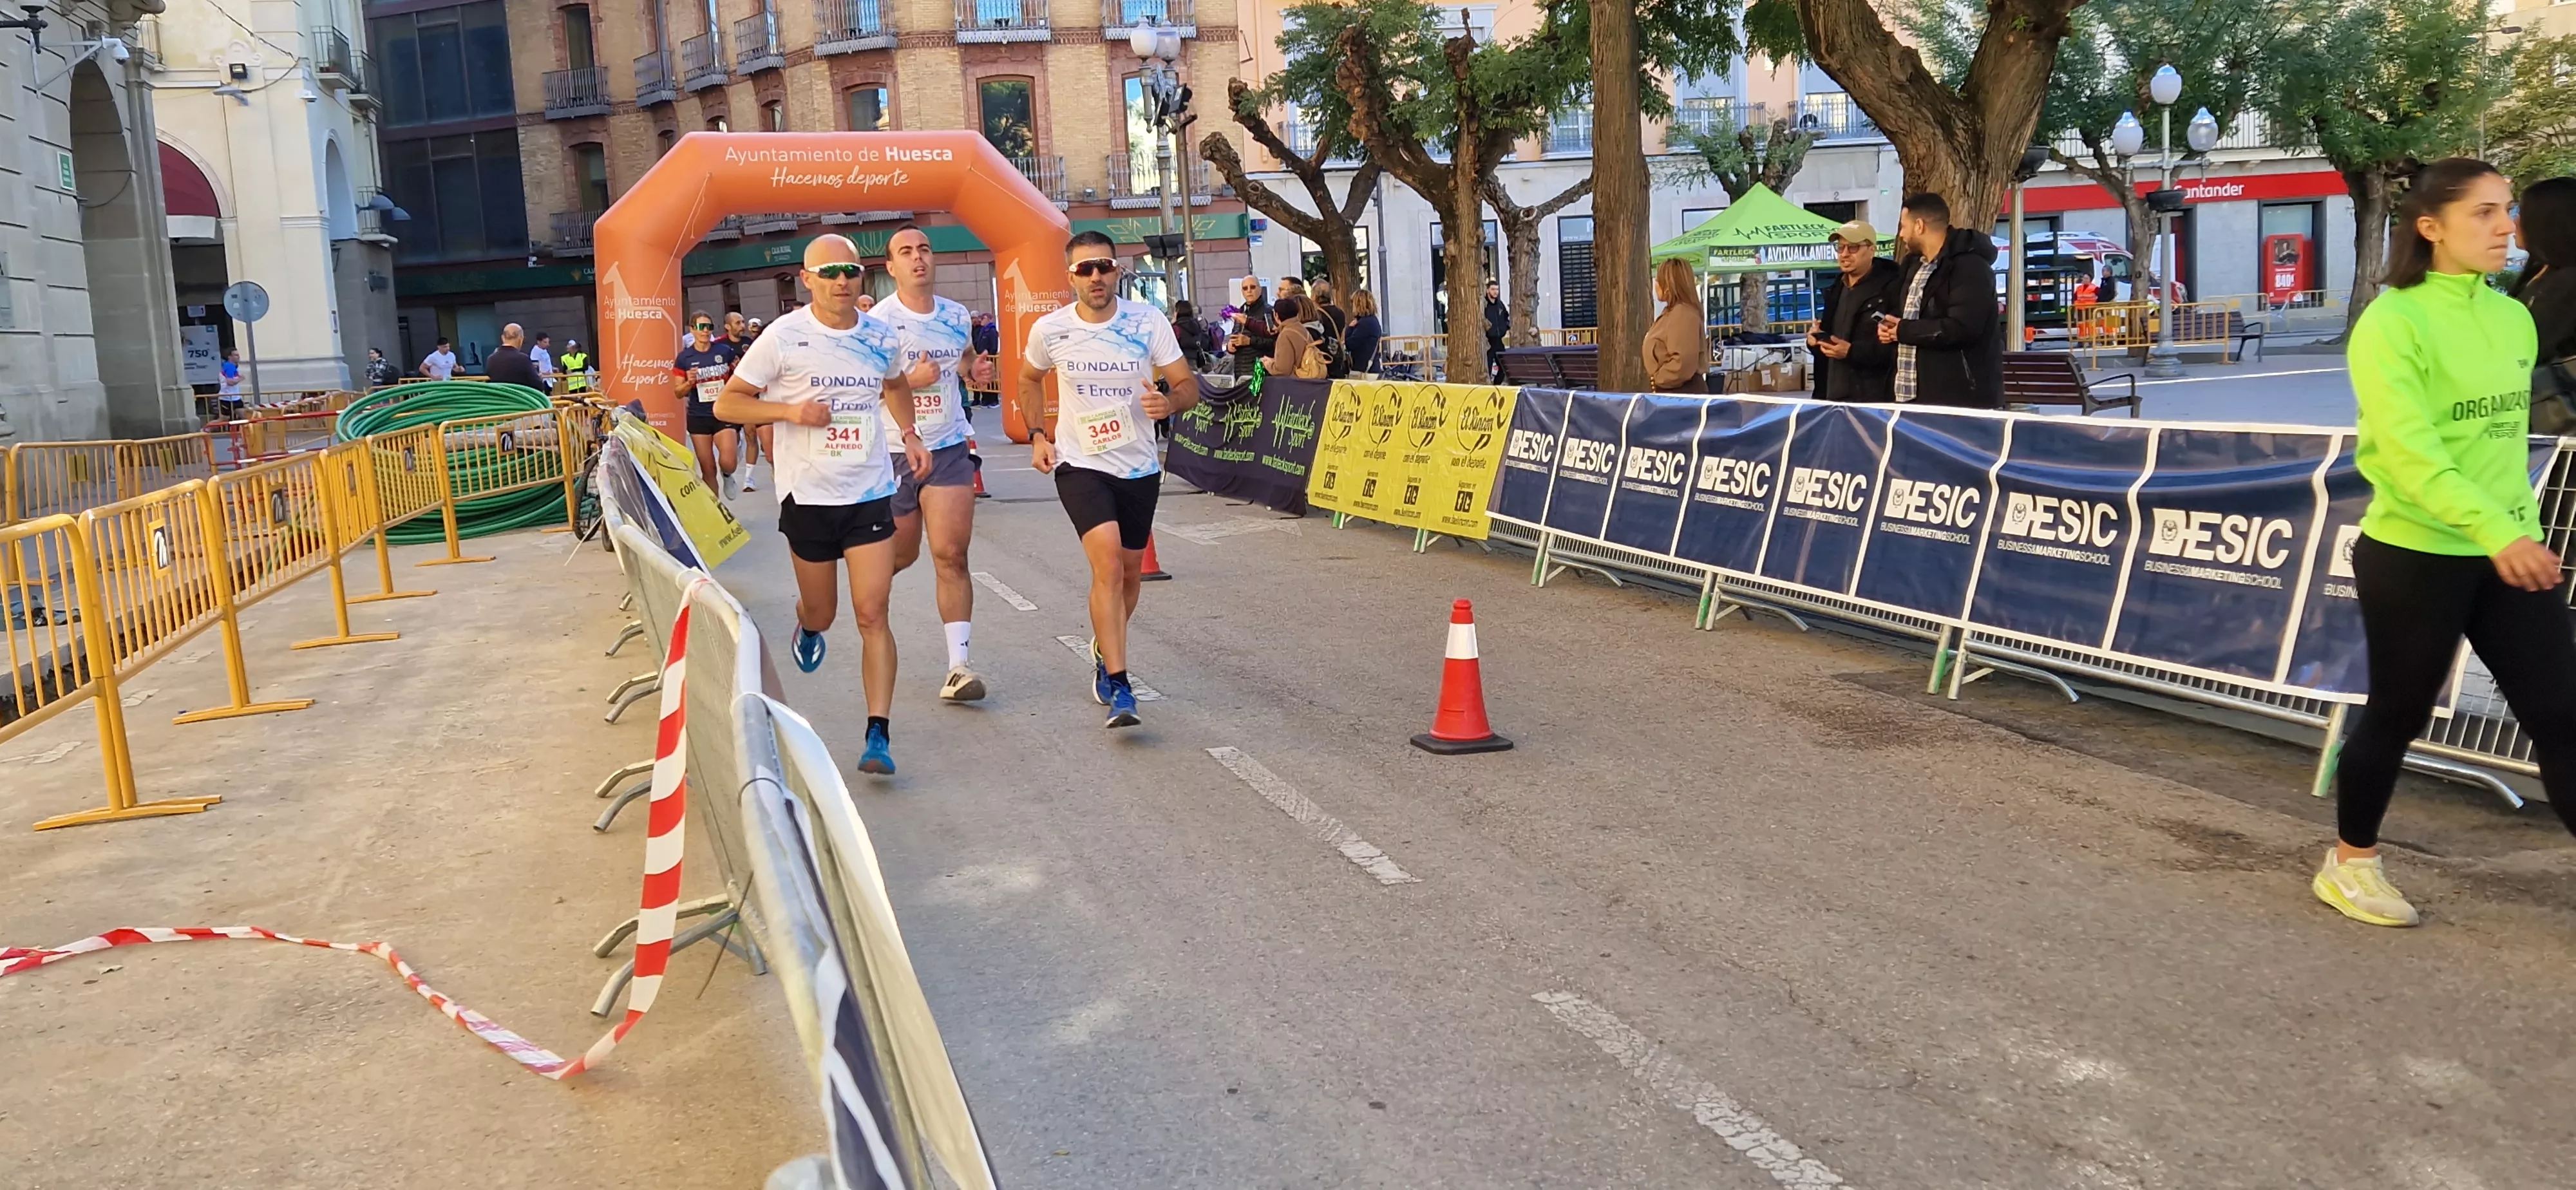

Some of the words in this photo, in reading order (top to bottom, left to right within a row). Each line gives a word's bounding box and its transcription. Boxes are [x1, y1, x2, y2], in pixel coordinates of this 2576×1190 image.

[725, 146, 853, 166] Ayuntamiento
[858, 146, 880, 162] de
[885, 146, 953, 162] Huesca
[770, 166, 843, 189] Hacemos
[846, 164, 910, 194] deporte
[1765, 223, 1826, 232] FARTLECK
[603, 295, 676, 308] Ayuntamiento
[1005, 289, 1070, 301] Ayuntamiento
[604, 309, 616, 319] de
[618, 309, 662, 319] Huesca
[1005, 303, 1016, 312] de
[1019, 303, 1058, 312] Huesca
[620, 354, 675, 369] Hacemos
[908, 348, 963, 360] BNDALT
[1067, 361, 1140, 372] BONDALTI
[622, 369, 669, 392] deporte
[1089, 384, 1133, 397] Ercros
[913, 395, 942, 408] 339
[826, 427, 860, 442] 341
[1088, 419, 1121, 439] 340
[1092, 432, 1122, 446] CARLOS
[1520, 430, 1554, 463] ESIC
[1577, 439, 1615, 473] ESIC
[1641, 448, 1686, 485] ESIC
[1714, 457, 1771, 498] ESIC
[680, 480, 696, 498] con
[1805, 469, 1867, 513] ESIC
[1904, 480, 1981, 529] ESIC
[2031, 495, 2118, 548] ESIC
[2183, 511, 2293, 570] ESIC
